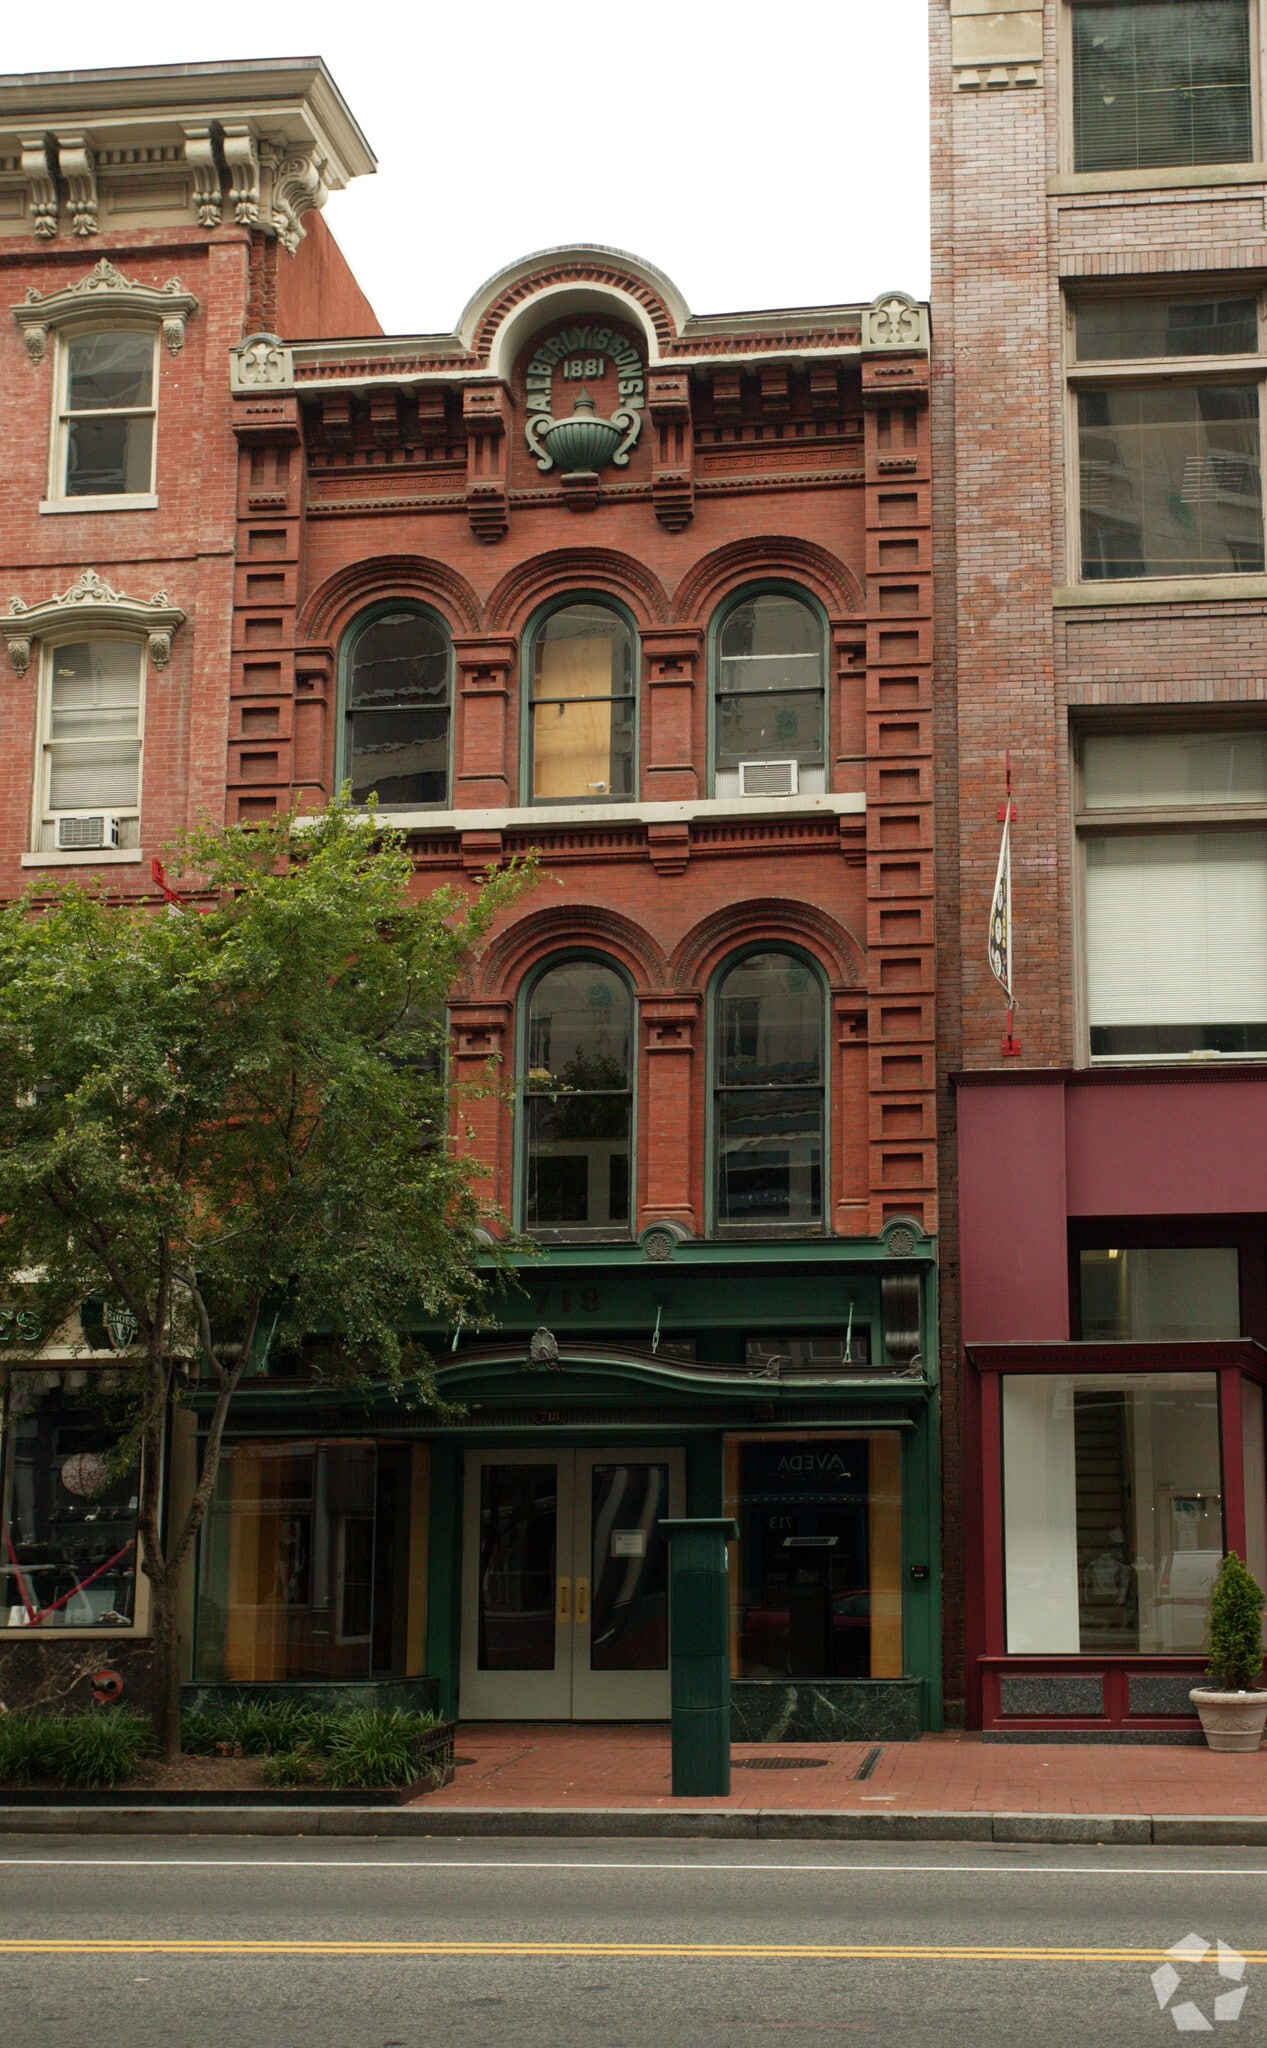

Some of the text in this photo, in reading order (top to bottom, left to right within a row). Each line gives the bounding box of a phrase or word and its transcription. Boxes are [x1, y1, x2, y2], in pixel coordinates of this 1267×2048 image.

[564, 359, 604, 378] 1881
[533, 1287, 600, 1313] 718
[107, 1310, 137, 1328] SHOES
[540, 1410, 560, 1422] 718
